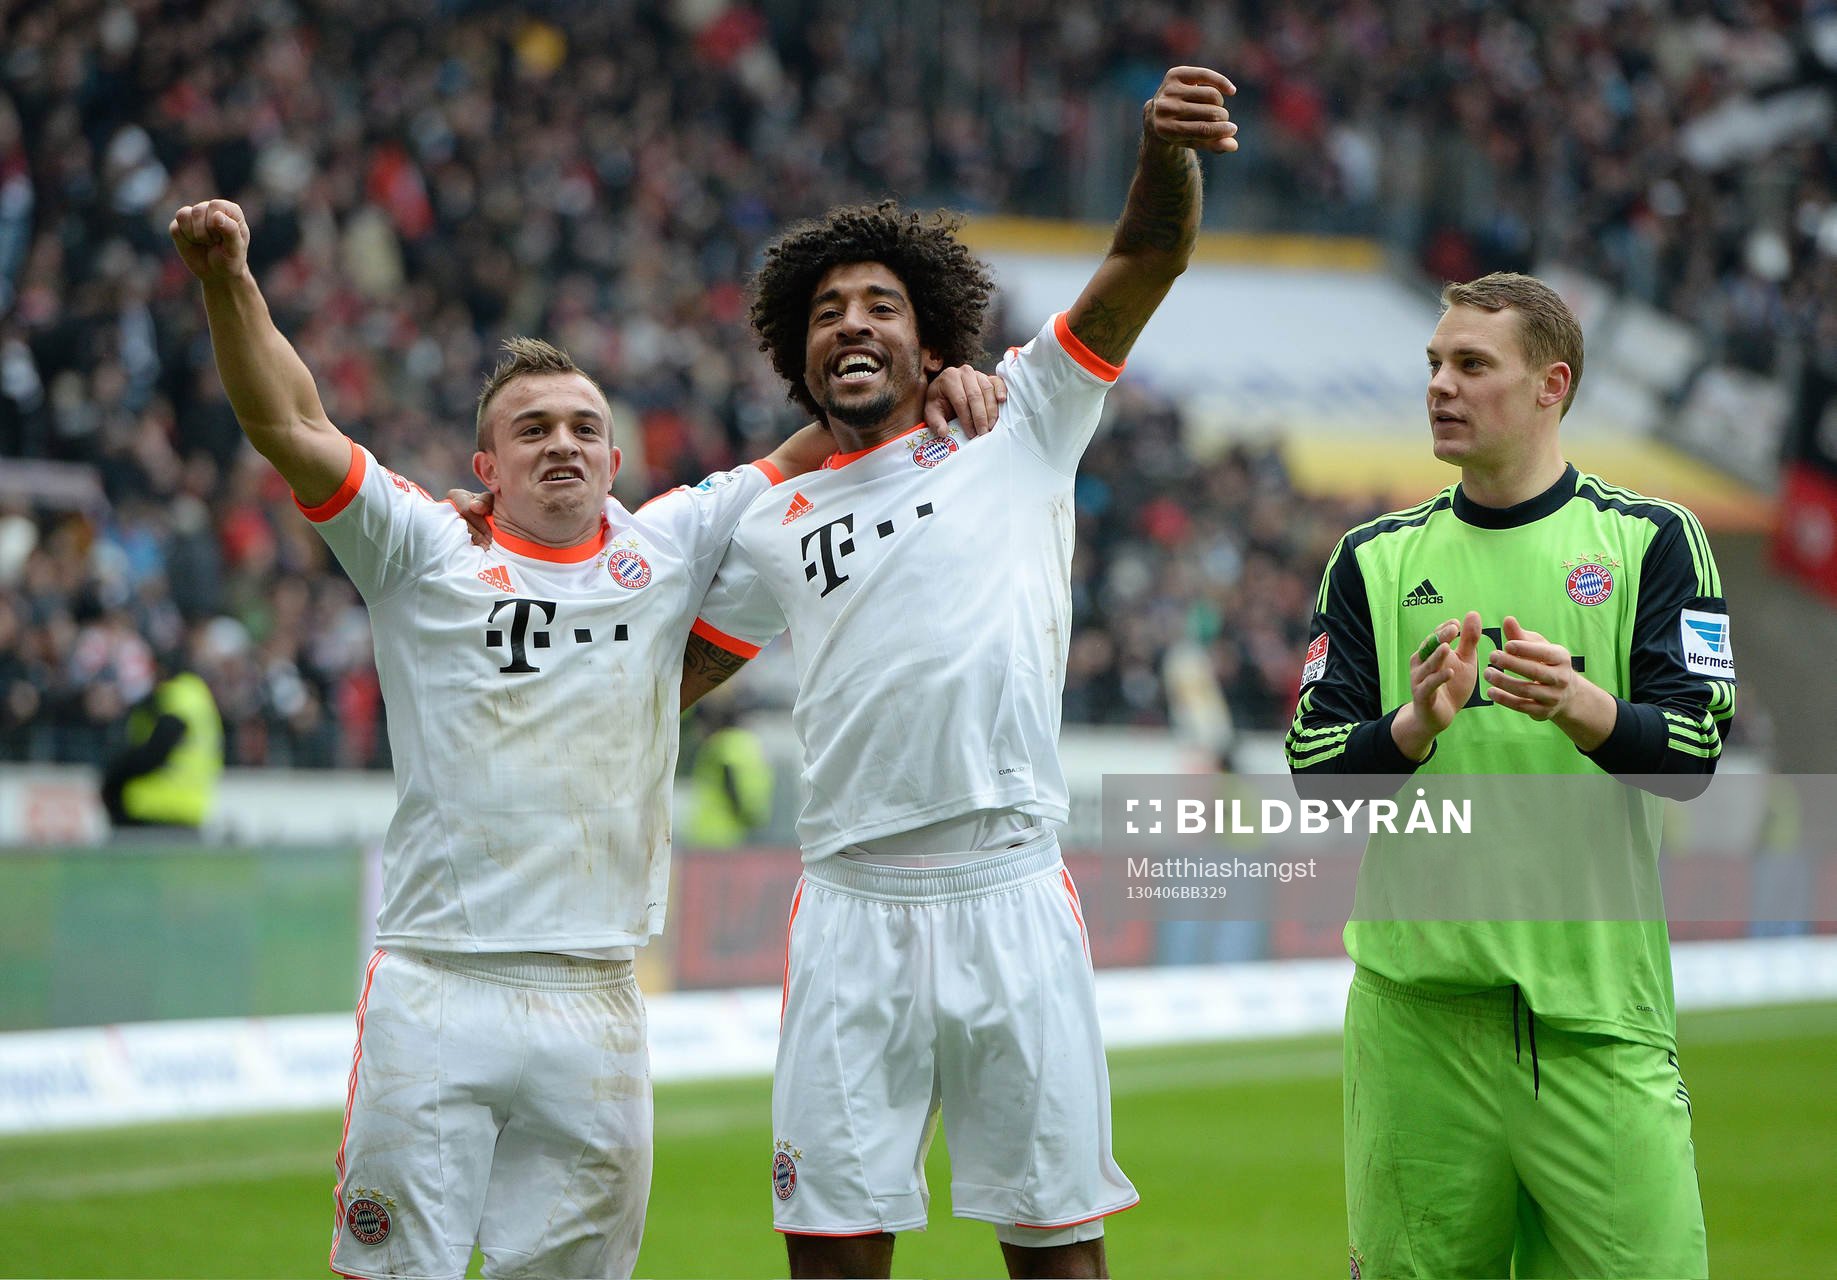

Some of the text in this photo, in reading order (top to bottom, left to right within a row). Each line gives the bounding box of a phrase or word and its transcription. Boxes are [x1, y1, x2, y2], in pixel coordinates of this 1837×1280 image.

[782, 502, 814, 525] adidas
[614, 551, 643, 563] BAYERN
[478, 572, 516, 593] adidas
[1570, 565, 1611, 583] FC BAYERN
[1402, 595, 1444, 607] adidas
[1688, 652, 1735, 669] Hermes
[357, 1202, 387, 1222] BAYERN
